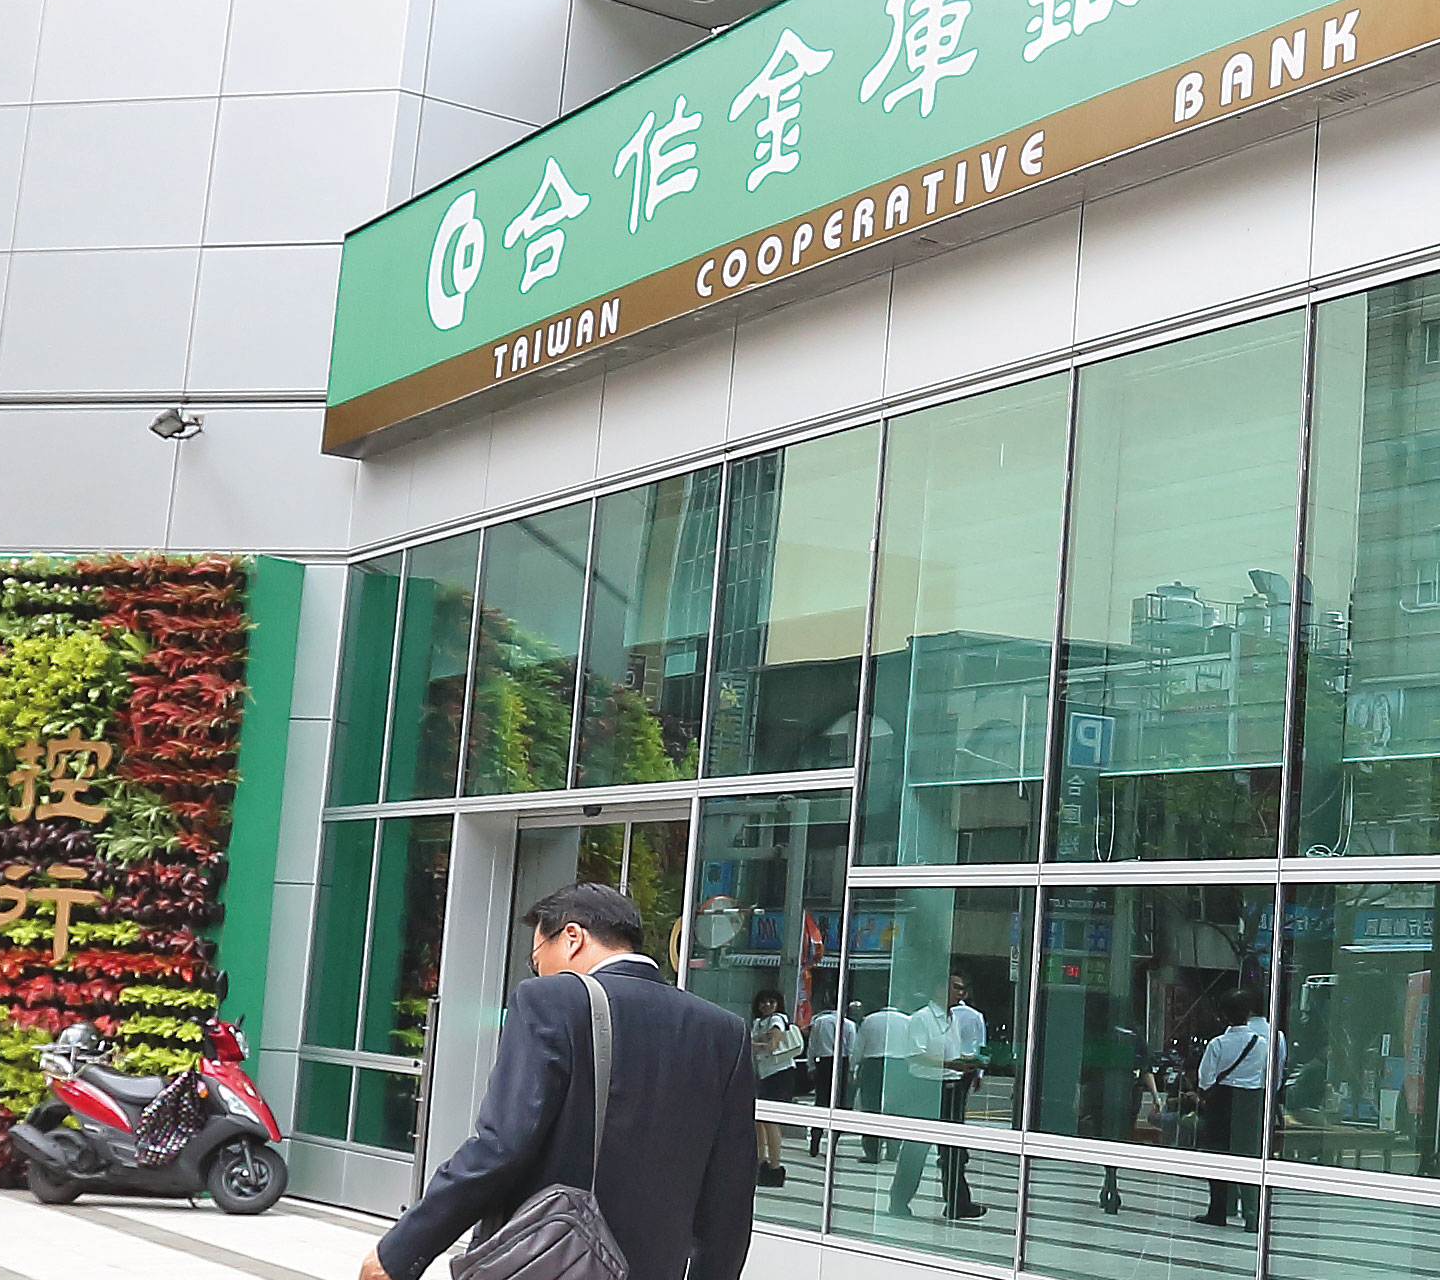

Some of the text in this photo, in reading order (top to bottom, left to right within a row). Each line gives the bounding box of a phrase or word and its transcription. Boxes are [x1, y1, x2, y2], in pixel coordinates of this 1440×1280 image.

[492, 8, 1362, 380] TAIWAN COOPERATIVE BANK
